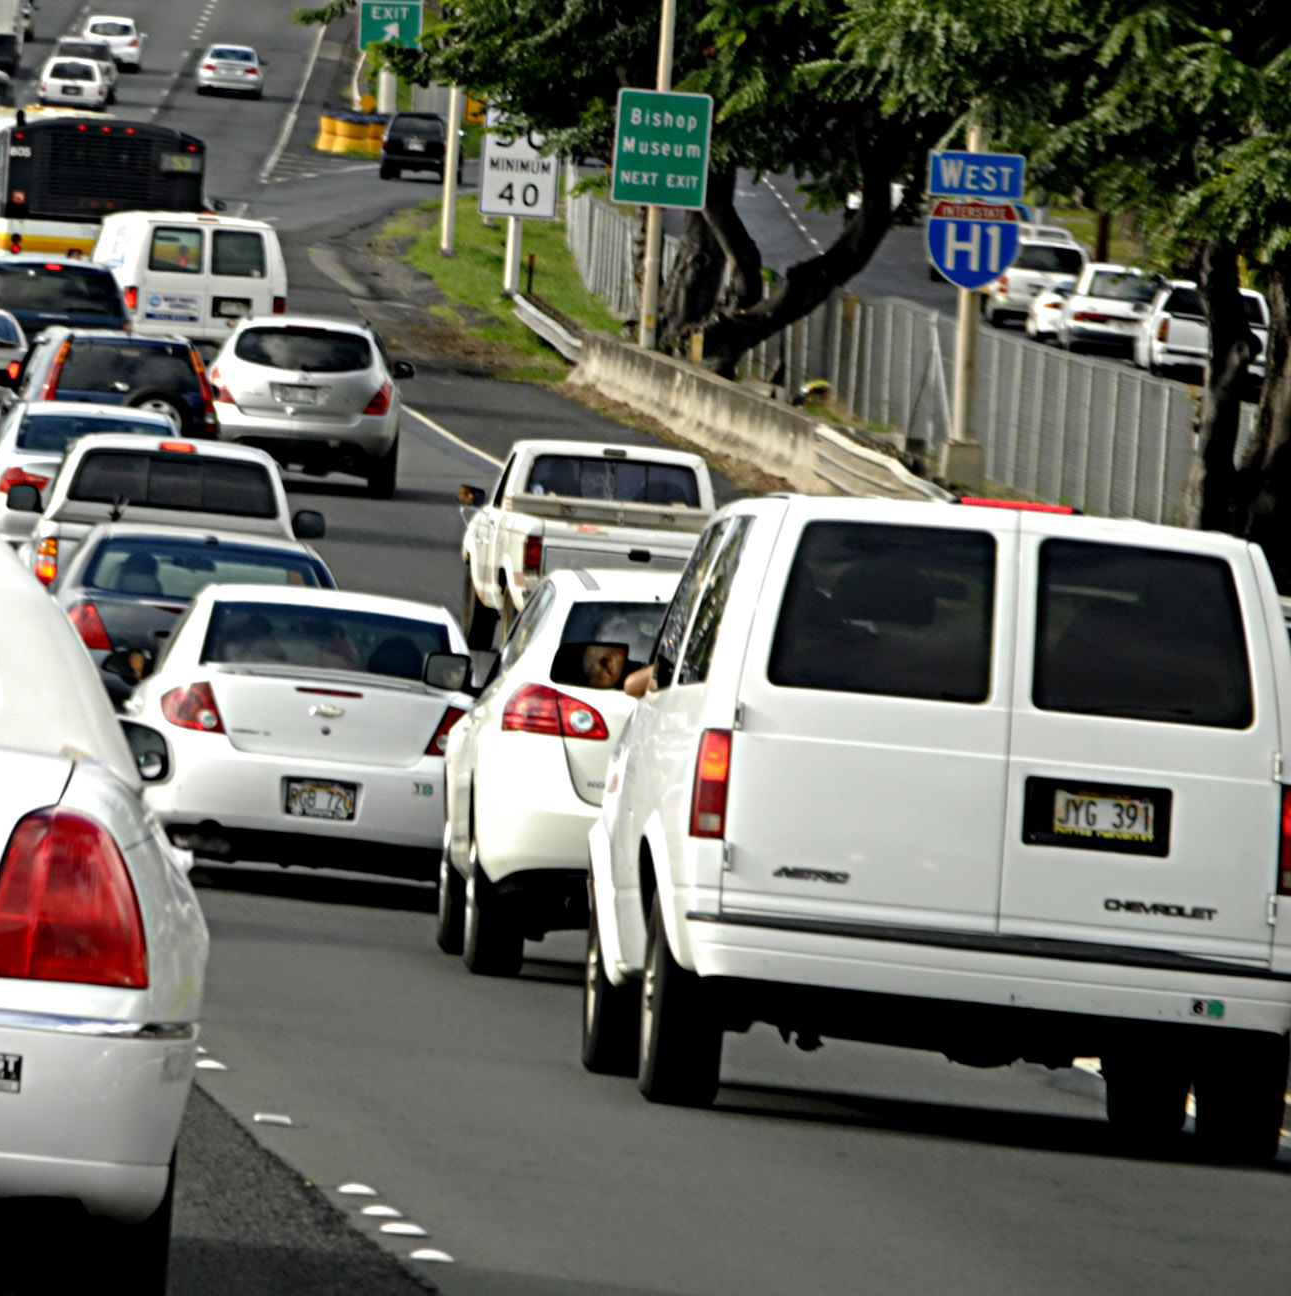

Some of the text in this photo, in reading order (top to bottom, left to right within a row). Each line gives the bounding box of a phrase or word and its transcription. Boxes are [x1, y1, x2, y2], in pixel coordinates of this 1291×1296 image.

[371, 5, 410, 21] EXIT
[631, 107, 698, 133] Bishop
[622, 135, 701, 158] Museum
[490, 157, 551, 175] MINIMUM
[940, 158, 1015, 192] WEST
[621, 170, 699, 189] NEXT EXIT
[498, 182, 539, 207] 40
[941, 205, 1007, 221] INTERSTATE
[944, 221, 1002, 273] H1
[1057, 799, 1150, 832] JYG 391
[1103, 898, 1218, 921] CHEVROLET
